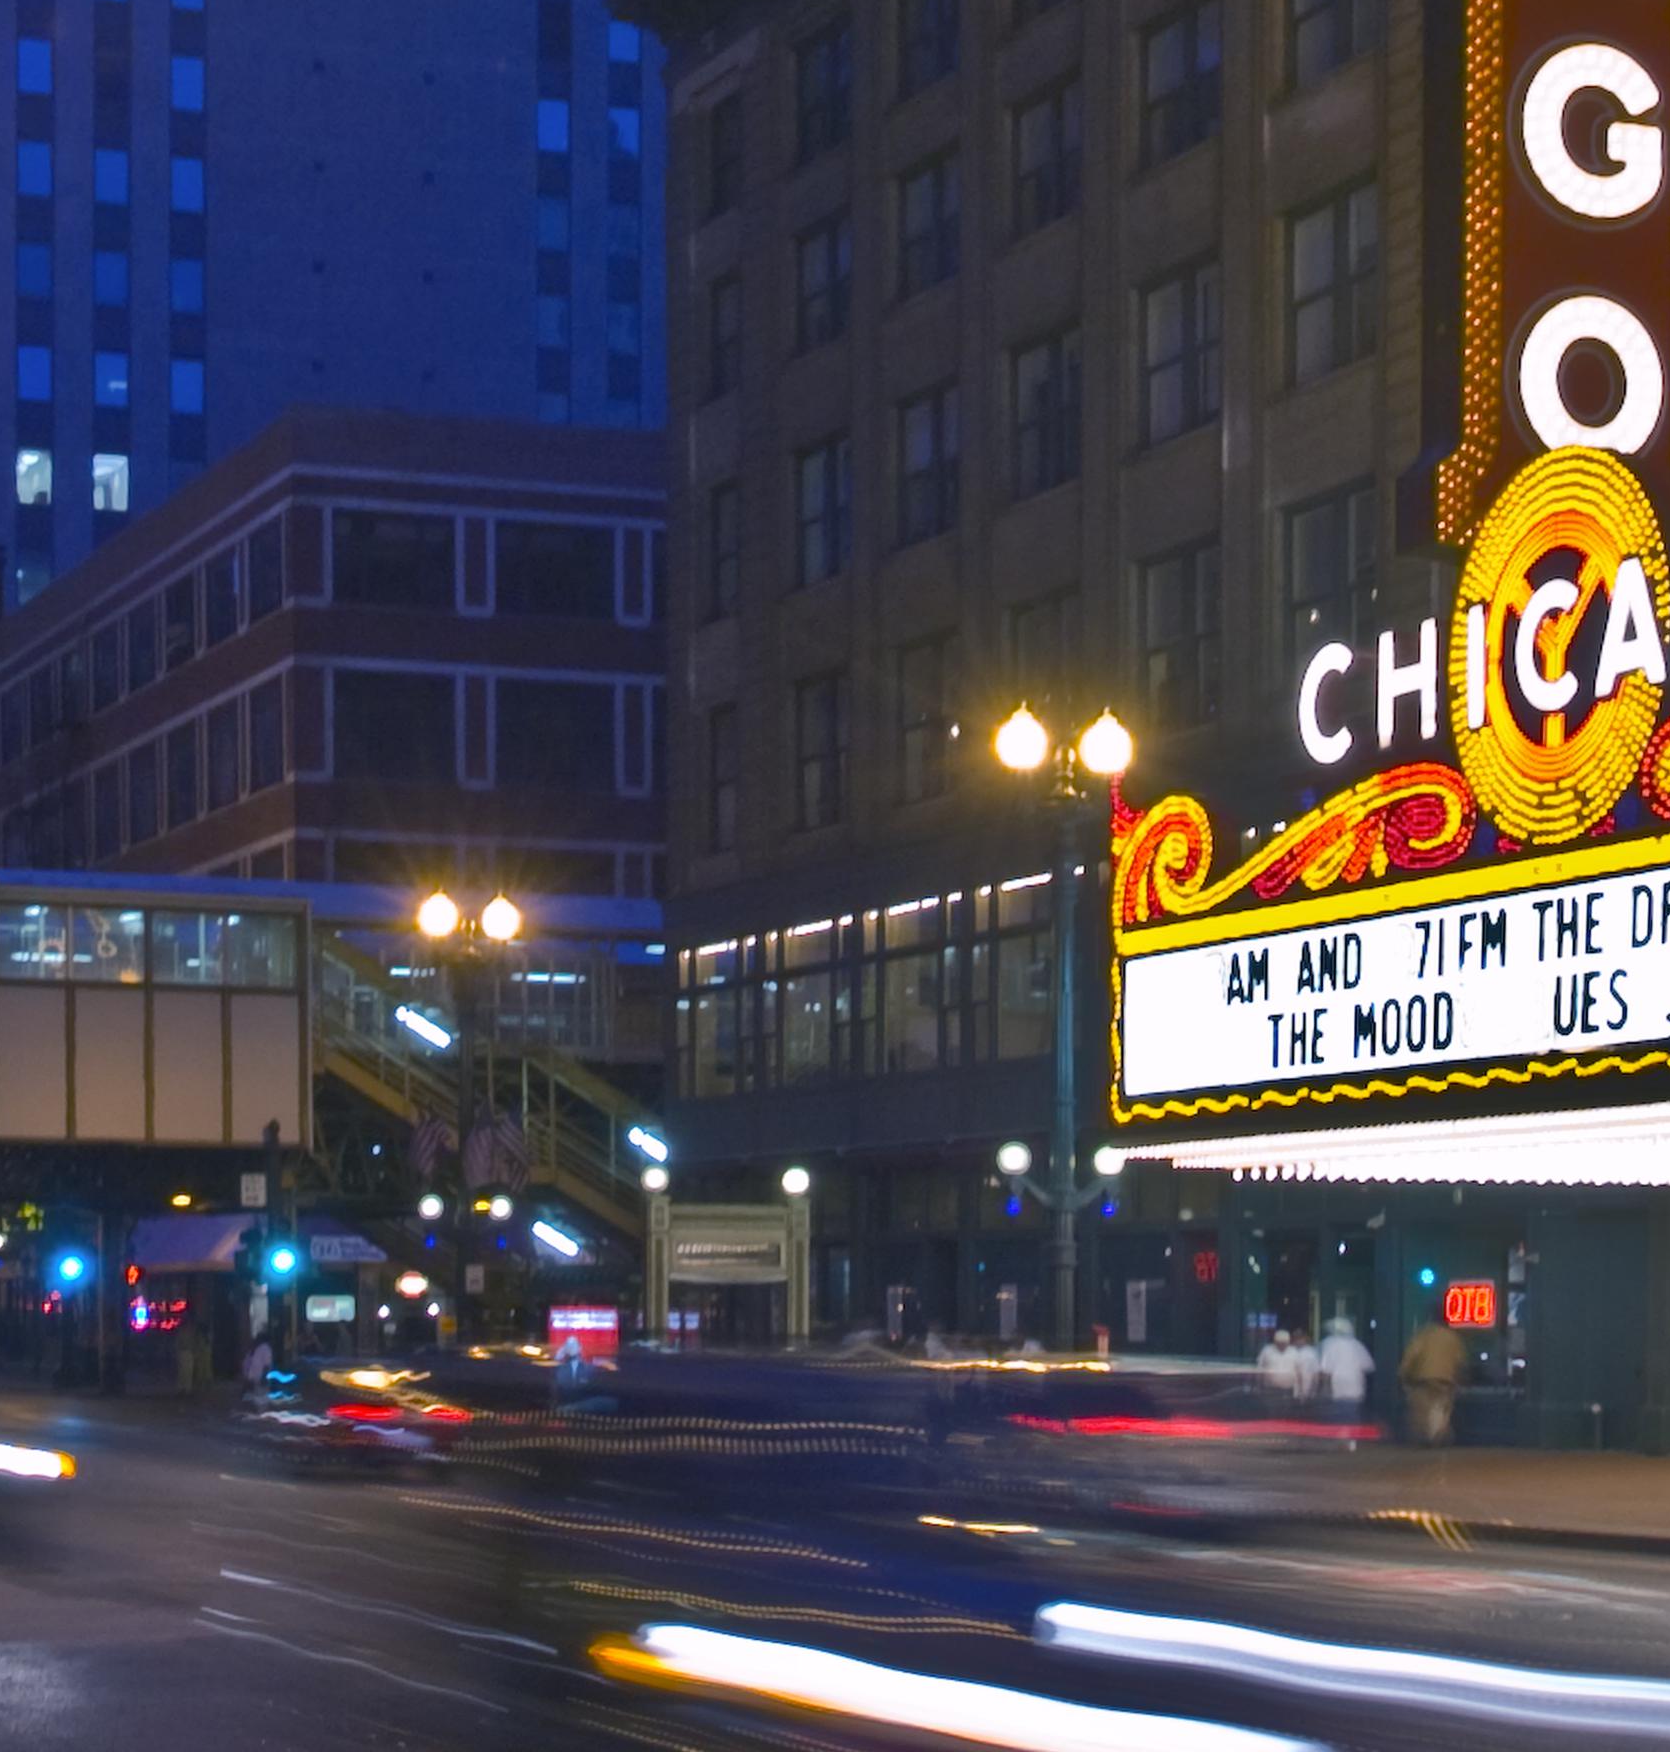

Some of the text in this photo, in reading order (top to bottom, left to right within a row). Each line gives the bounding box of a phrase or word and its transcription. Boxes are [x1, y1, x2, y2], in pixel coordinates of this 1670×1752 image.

[1227, 948, 1269, 1006] AM
[1298, 933, 1361, 994] AND
[1533, 893, 1603, 961] THE
[1268, 1009, 1327, 1068] THE
[1354, 992, 1453, 1058] MOOD
[1554, 969, 1627, 1036] UES
